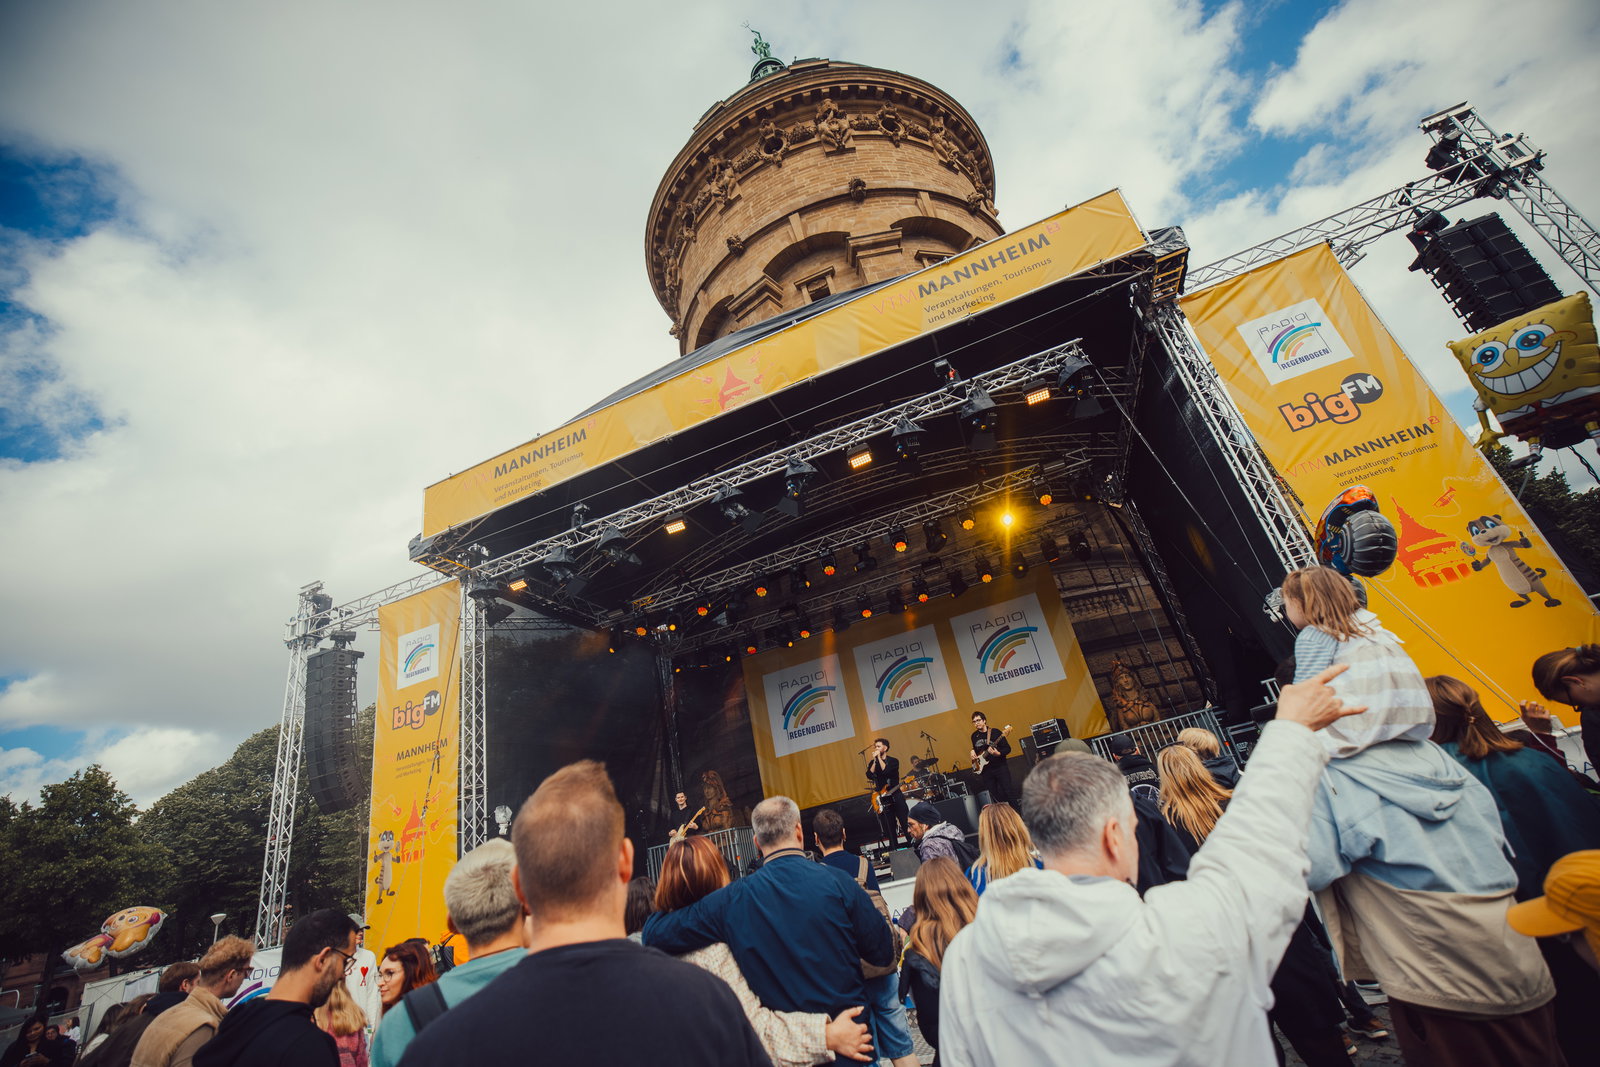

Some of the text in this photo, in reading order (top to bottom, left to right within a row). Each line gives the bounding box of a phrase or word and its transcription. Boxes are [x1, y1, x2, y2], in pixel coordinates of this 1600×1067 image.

[923, 257, 1052, 313] Veranstaltungen, Tourismus
[927, 292, 996, 324] und Marketing
[1259, 312, 1308, 335] RADIO
[1281, 348, 1330, 370] REGENBOGEN
[1333, 442, 1438, 479] Veranstaltungen, Tourismus
[493, 451, 585, 493] Veranstaltungen, Tourismus
[1339, 465, 1396, 487] und Marketing
[507, 479, 542, 497] Marketing
[972, 610, 1023, 634] RADIO
[406, 634, 431, 647] RADIO
[873, 641, 921, 663] RADIO
[780, 670, 825, 691] RADIO
[988, 661, 1042, 685] REGENBOGEN
[884, 692, 935, 714] REGENBOGEN
[788, 720, 836, 740] REGENBOGEN
[396, 738, 448, 762] MANNHEM
